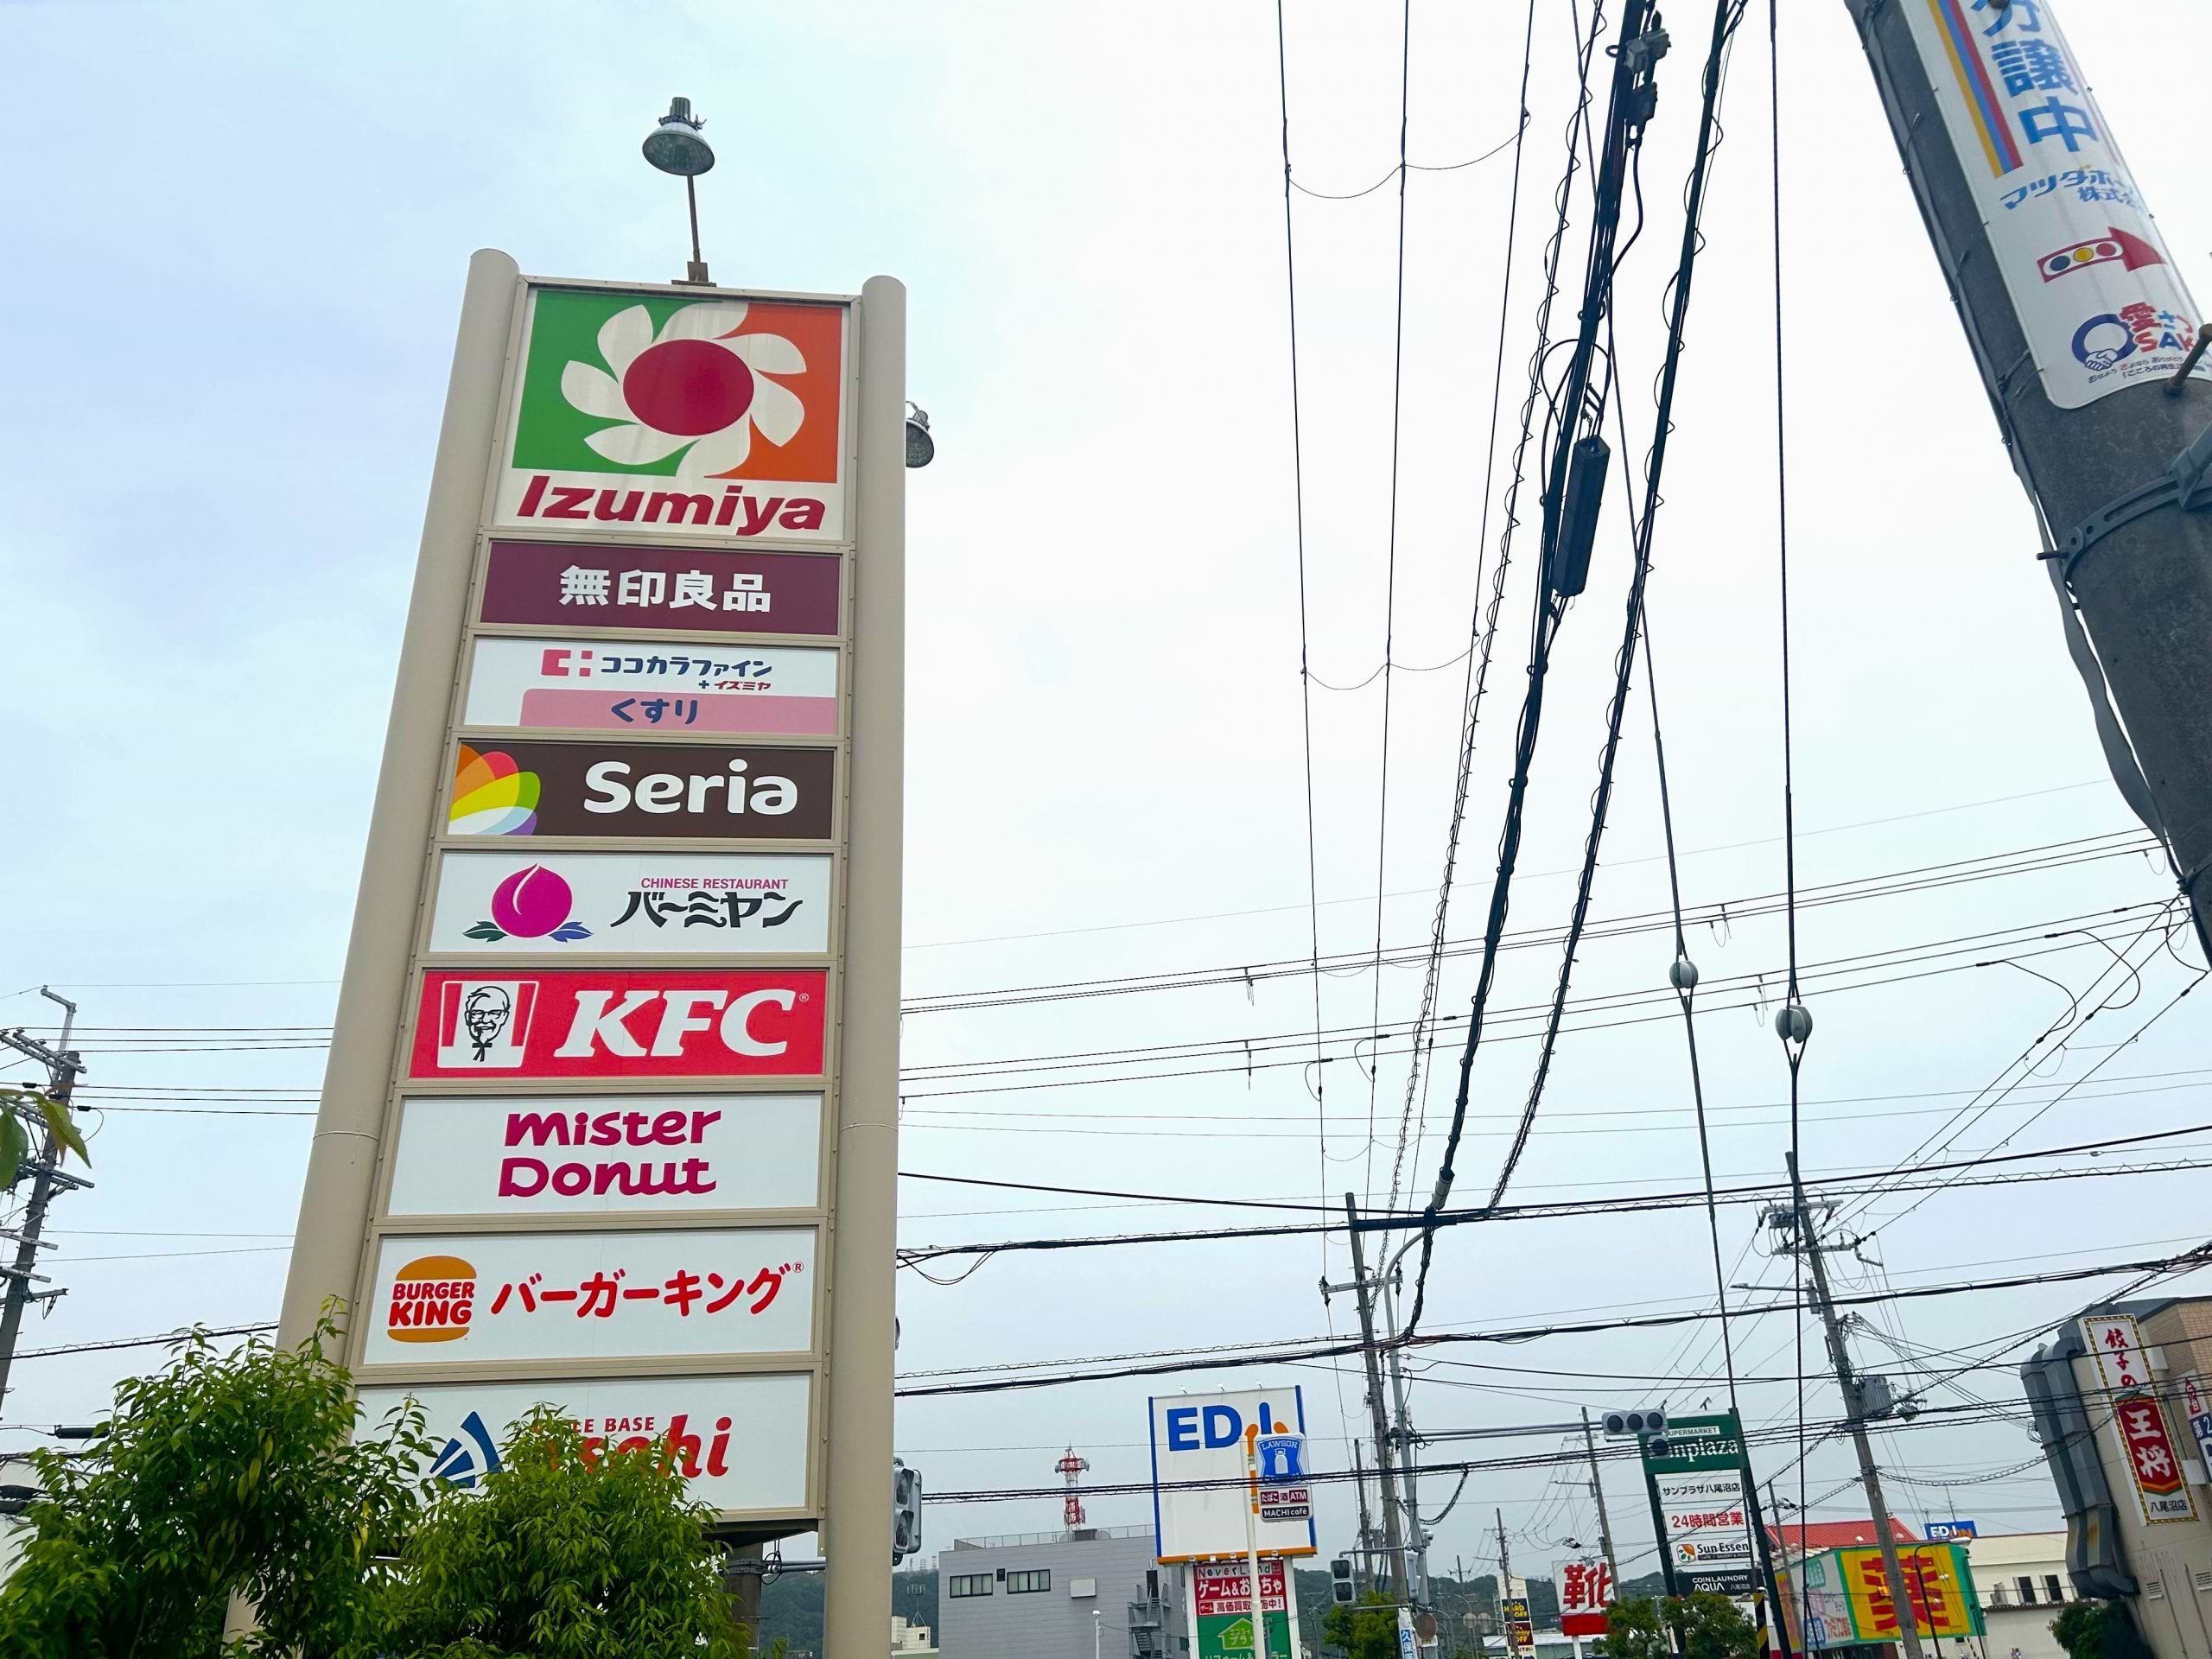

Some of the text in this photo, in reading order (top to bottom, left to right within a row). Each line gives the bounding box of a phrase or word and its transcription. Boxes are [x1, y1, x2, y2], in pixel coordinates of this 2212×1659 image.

[517, 475, 826, 536] Izumiya
[559, 564, 772, 613] 無印良品
[601, 656, 772, 677] ココカラファイン
[611, 698, 698, 724] くすり
[583, 759, 798, 815] Seria
[641, 878, 788, 889] CHINESE RESTAURANT
[610, 891, 804, 928] バーミヤン
[553, 989, 797, 1057] KFC
[499, 1157, 716, 1198] Donut
[392, 1281, 474, 1299] BURGER
[491, 1262, 791, 1319] バーガーキング
[388, 1300, 473, 1326] KING
[605, 1417, 655, 1432] BASE
[1262, 1440, 1298, 1451] LAWSON
[2129, 1408, 2171, 1478] 王将
[1290, 1491, 1306, 1501] ATM
[1263, 1509, 1289, 1517] MACHI
[1671, 1511, 1744, 1528] 24時間営業
[1198, 1564, 1271, 1579] NeverLnd
[1198, 1577, 1282, 1599] ゲーム&おちゃ
[1563, 1563, 1612, 1609] 靴
[1694, 1582, 1725, 1592] AQUA
